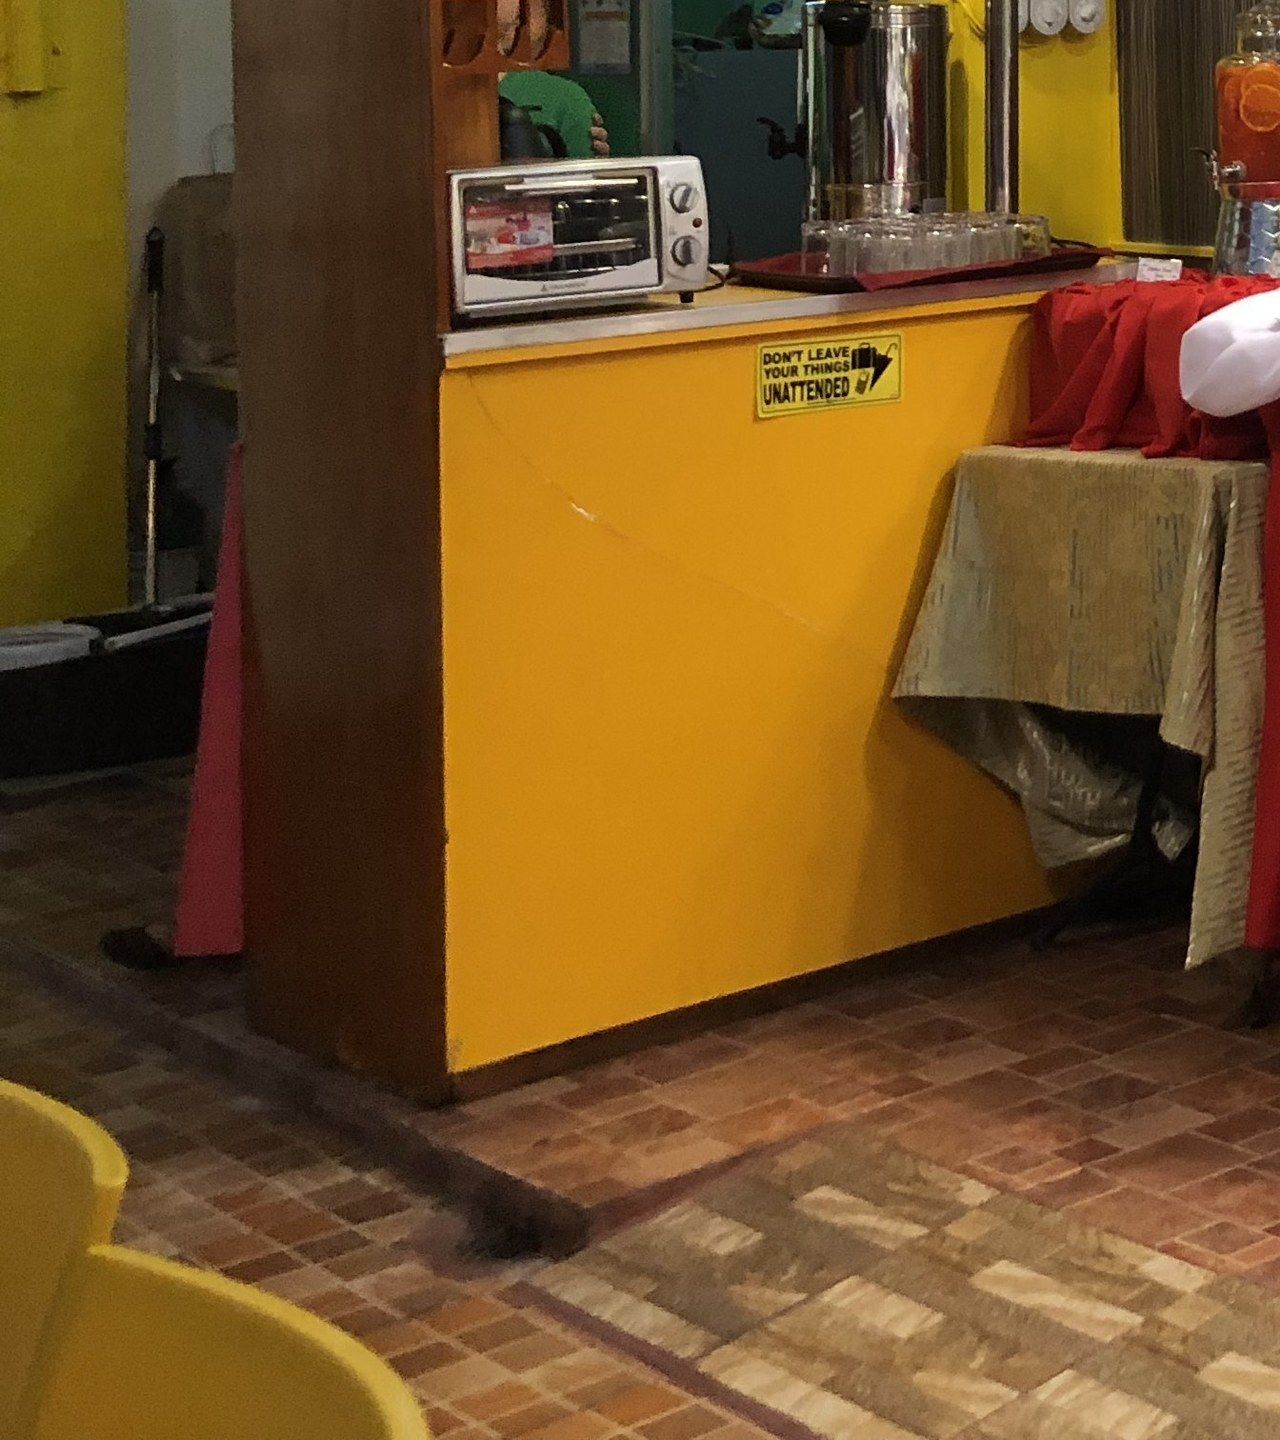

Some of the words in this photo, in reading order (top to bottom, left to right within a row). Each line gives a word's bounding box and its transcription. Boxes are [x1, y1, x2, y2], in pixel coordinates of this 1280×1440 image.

[763, 350, 803, 365] DON'T
[808, 346, 849, 361] LEAVE
[764, 365, 798, 379] YOUR
[803, 360, 850, 376] THINGS
[763, 376, 850, 406] UNATTENDED
